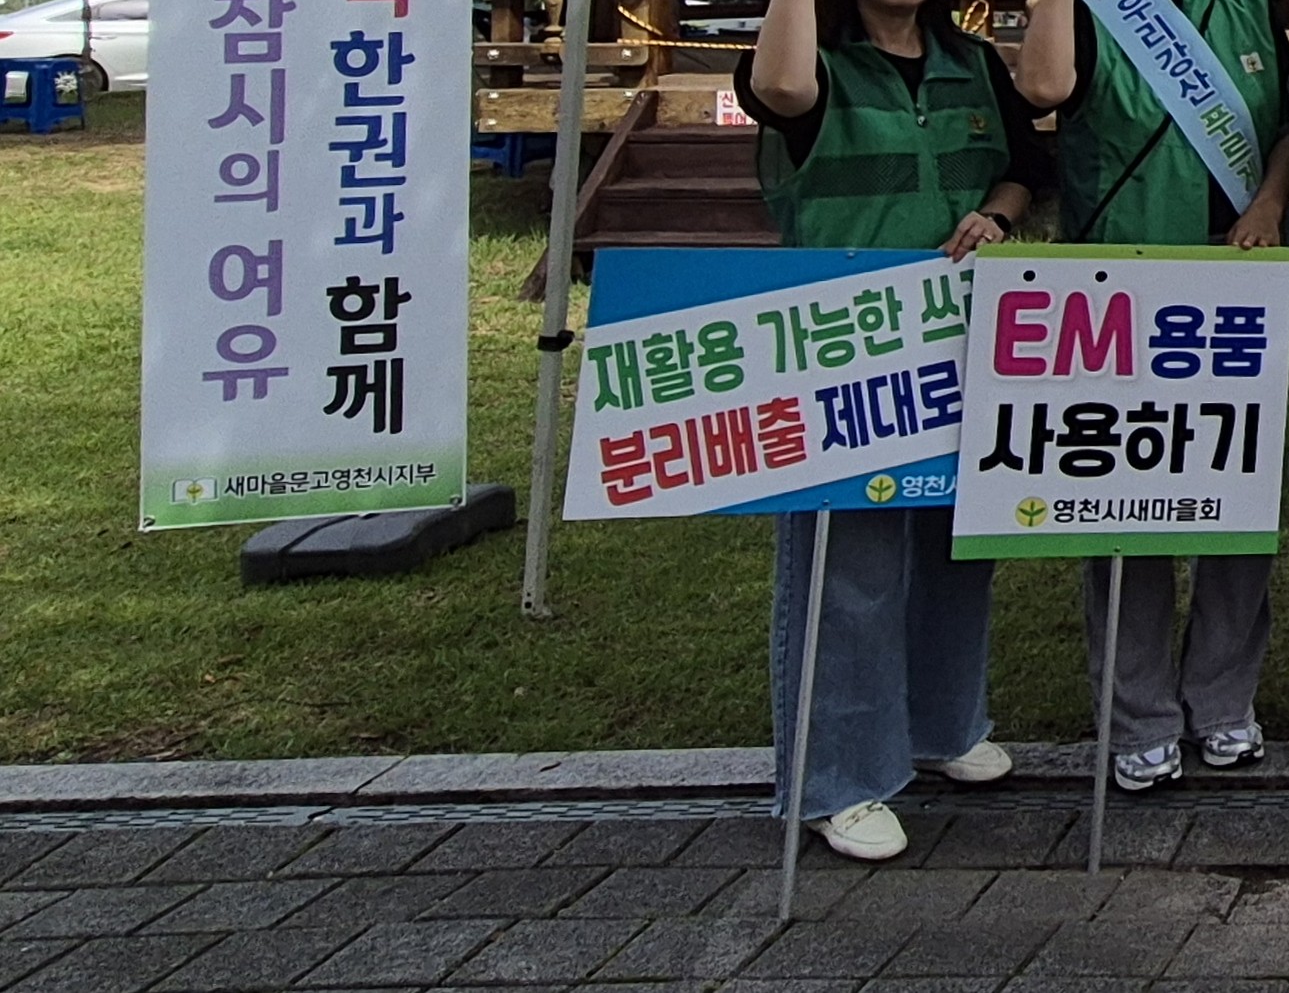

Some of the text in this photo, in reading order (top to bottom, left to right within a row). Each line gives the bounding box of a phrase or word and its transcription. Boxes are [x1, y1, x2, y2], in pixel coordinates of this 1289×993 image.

[328, 31, 414, 254] 한권과
[202, 243, 288, 401] 여유
[323, 276, 411, 434] 함께
[588, 320, 746, 411] 재활용
[757, 289, 903, 372] 가능한
[994, 290, 1268, 379] EM 용품
[224, 463, 436, 497] 새마을문고영천시지부
[598, 360, 962, 506] 분리배출 제대로
[978, 402, 1261, 477] 사용하기
[1053, 498, 1221, 524] 영천시새마을회
